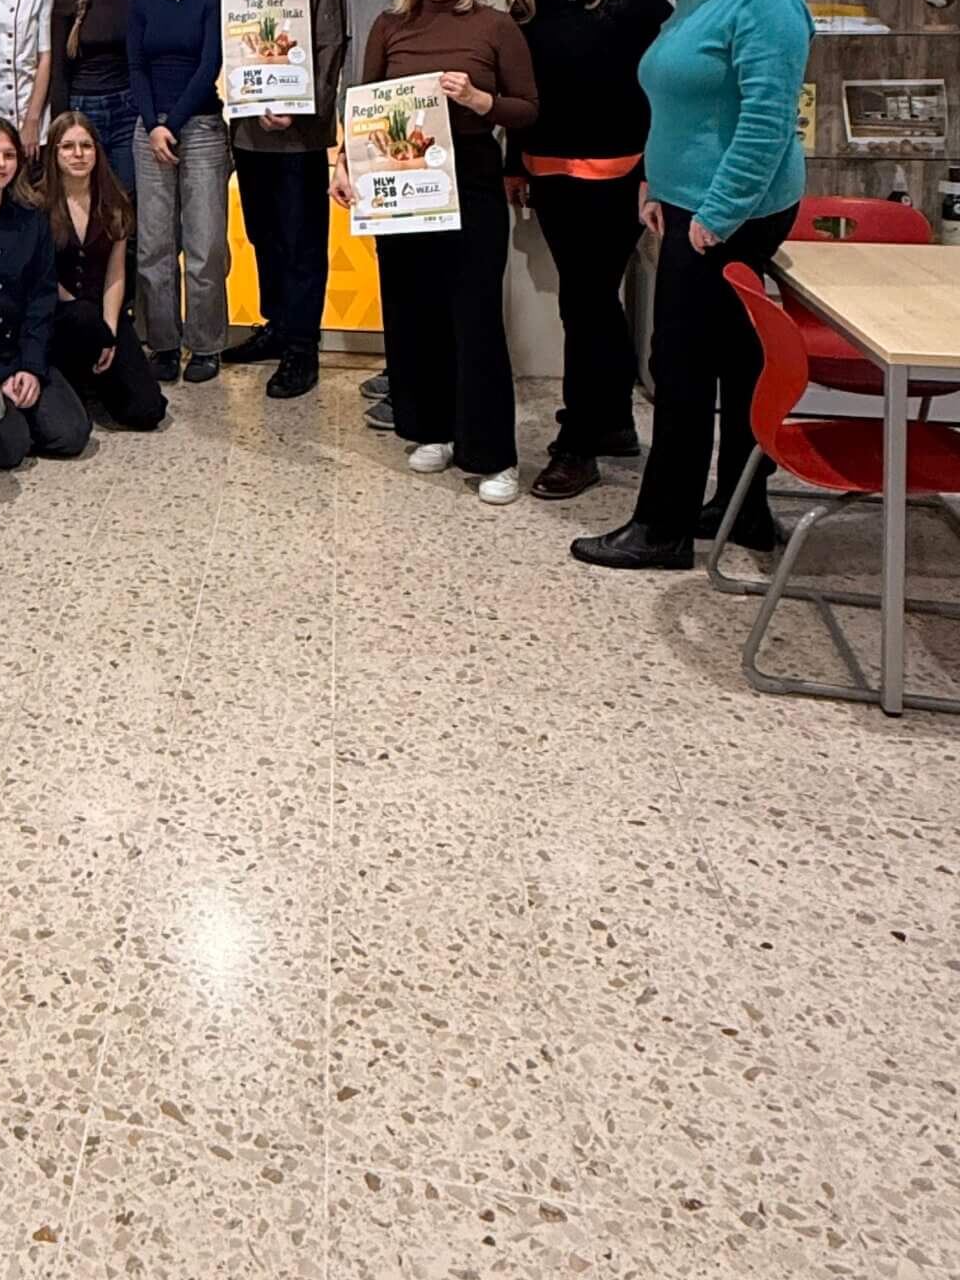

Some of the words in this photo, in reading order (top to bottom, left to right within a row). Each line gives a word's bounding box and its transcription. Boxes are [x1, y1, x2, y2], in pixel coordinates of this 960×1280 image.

[372, 88, 392, 101] Tag
[396, 85, 415, 96] der
[373, 176, 396, 187] HLW
[374, 186, 397, 197] FSB
